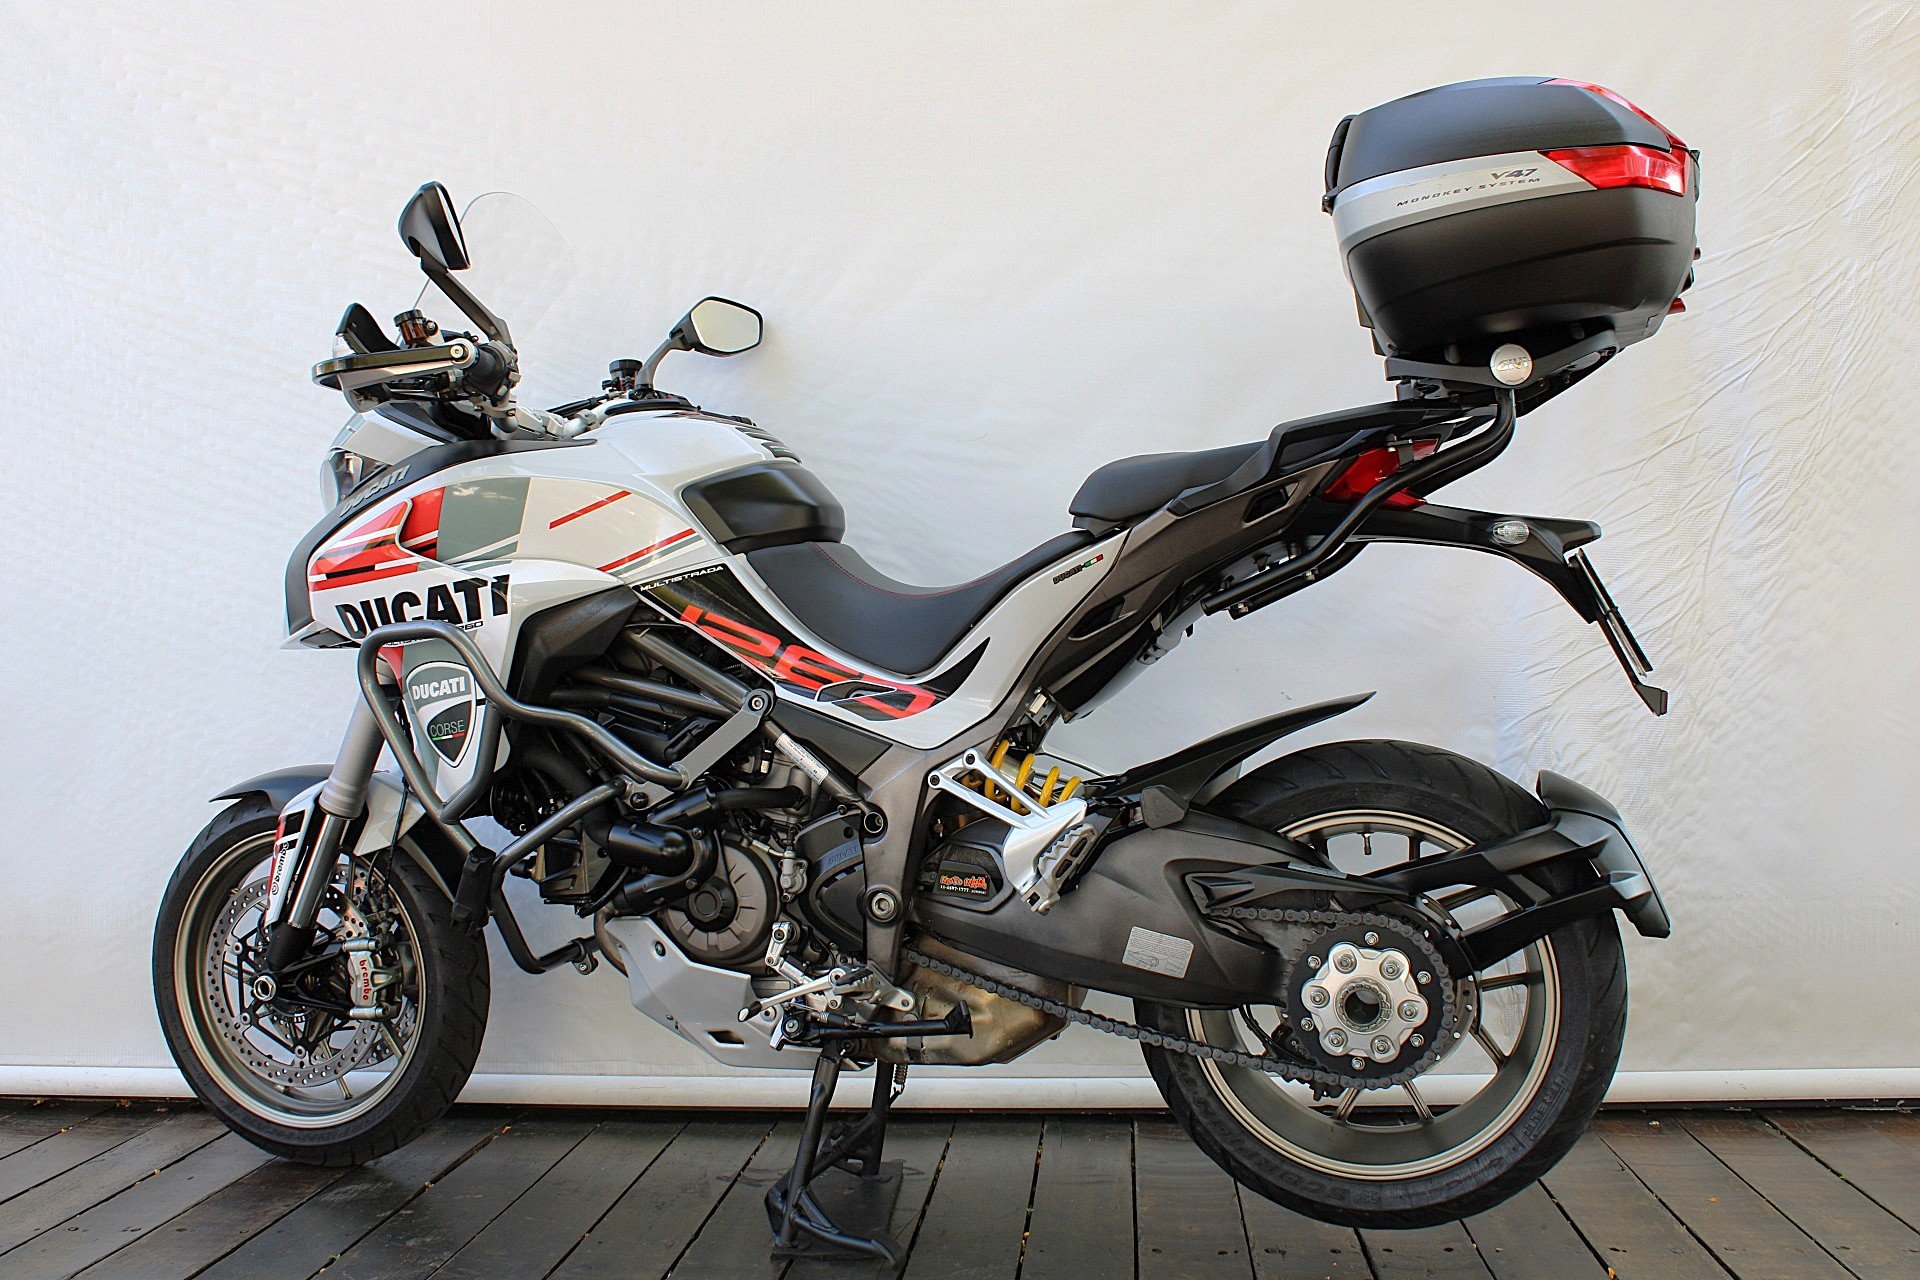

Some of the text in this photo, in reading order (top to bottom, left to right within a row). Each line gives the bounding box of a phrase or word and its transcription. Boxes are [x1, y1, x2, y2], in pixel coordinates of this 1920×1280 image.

[1491, 168, 1539, 180] V47
[1396, 178, 1541, 207] MONOKEY SYSTEM
[340, 464, 411, 517] DUCATI
[640, 565, 724, 592] MULTISTRADA
[1052, 564, 1083, 585] DUCATI
[335, 574, 510, 639] DUCATI
[411, 676, 466, 700] DUCATI
[430, 720, 465, 737] CORSE
[274, 841, 289, 882] brembo
[360, 959, 372, 1000] brembo
